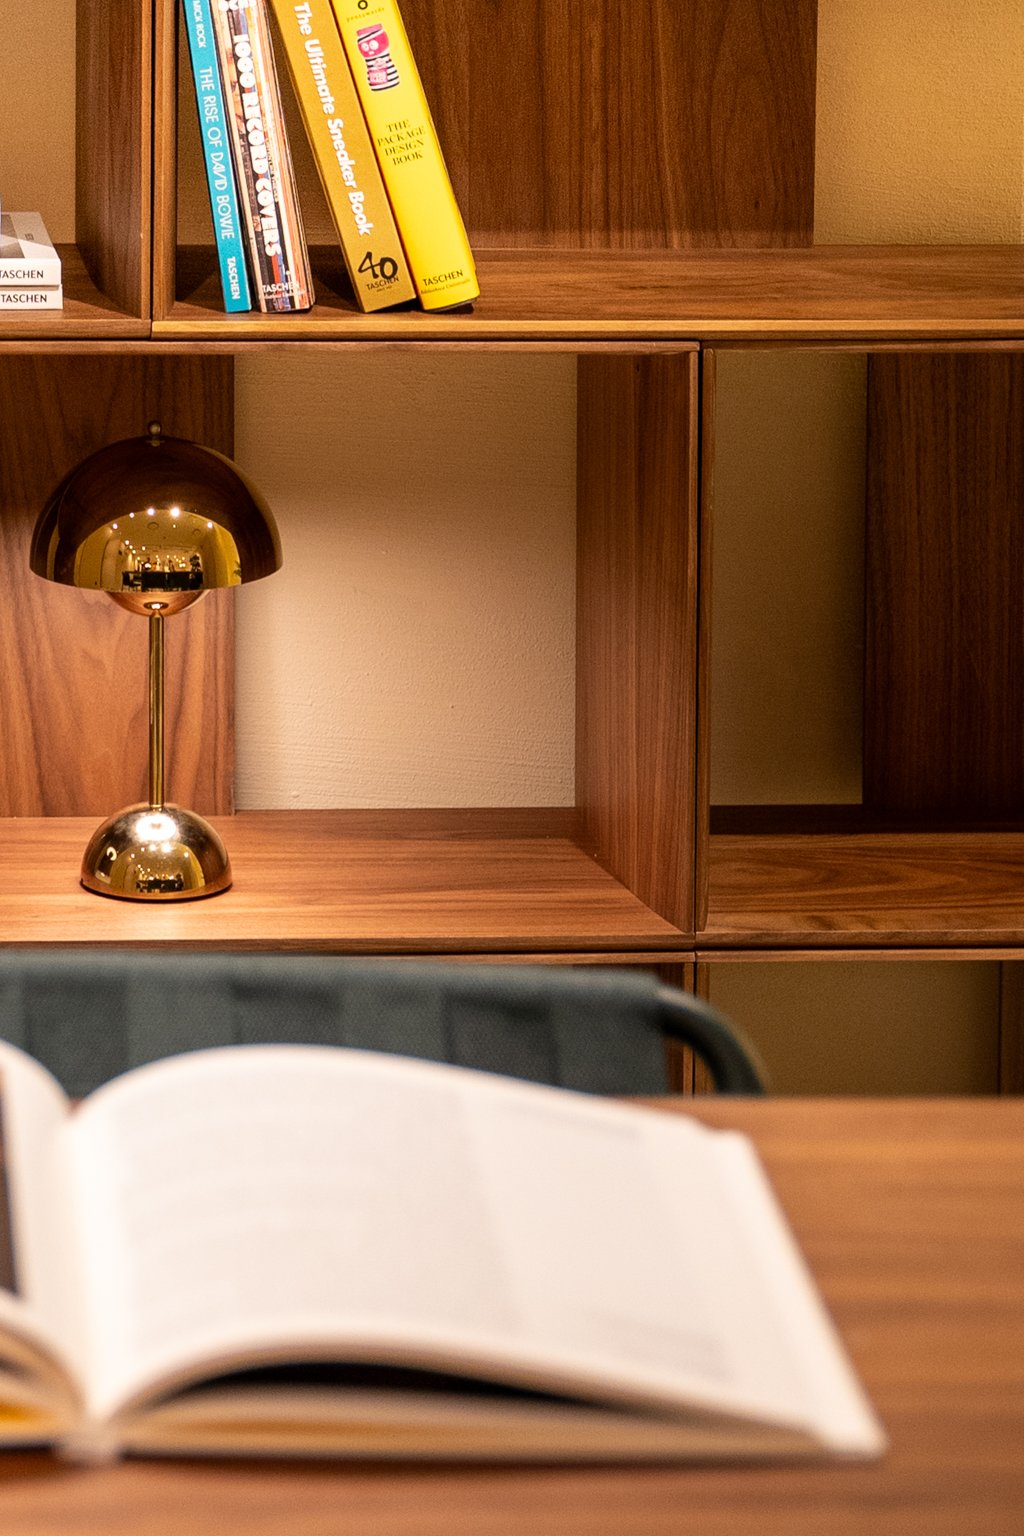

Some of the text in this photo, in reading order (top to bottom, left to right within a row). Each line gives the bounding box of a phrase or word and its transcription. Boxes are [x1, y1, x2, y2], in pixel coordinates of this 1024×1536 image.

[192, 0, 207, 48] MICK ROCK
[233, 34, 256, 88] 1000
[294, 1, 374, 236] The Ultimate Sneaker Book
[387, 119, 411, 133] THE
[242, 91, 269, 175] RECORD
[377, 126, 426, 147] PACKAGE
[199, 66, 235, 240] THE RISE OF DAVID BOWIE
[385, 140, 425, 157] DESIGN
[392, 151, 424, 166] BOOK
[255, 178, 282, 257] COVERS
[227, 256, 241, 300] TASCHEN
[357, 251, 398, 280] 40
[422, 269, 464, 286] TASCHEN
[261, 280, 300, 293] TASCHEN
[365, 276, 400, 291] TASCHEN
[1, 294, 47, 303] TASCHEN
